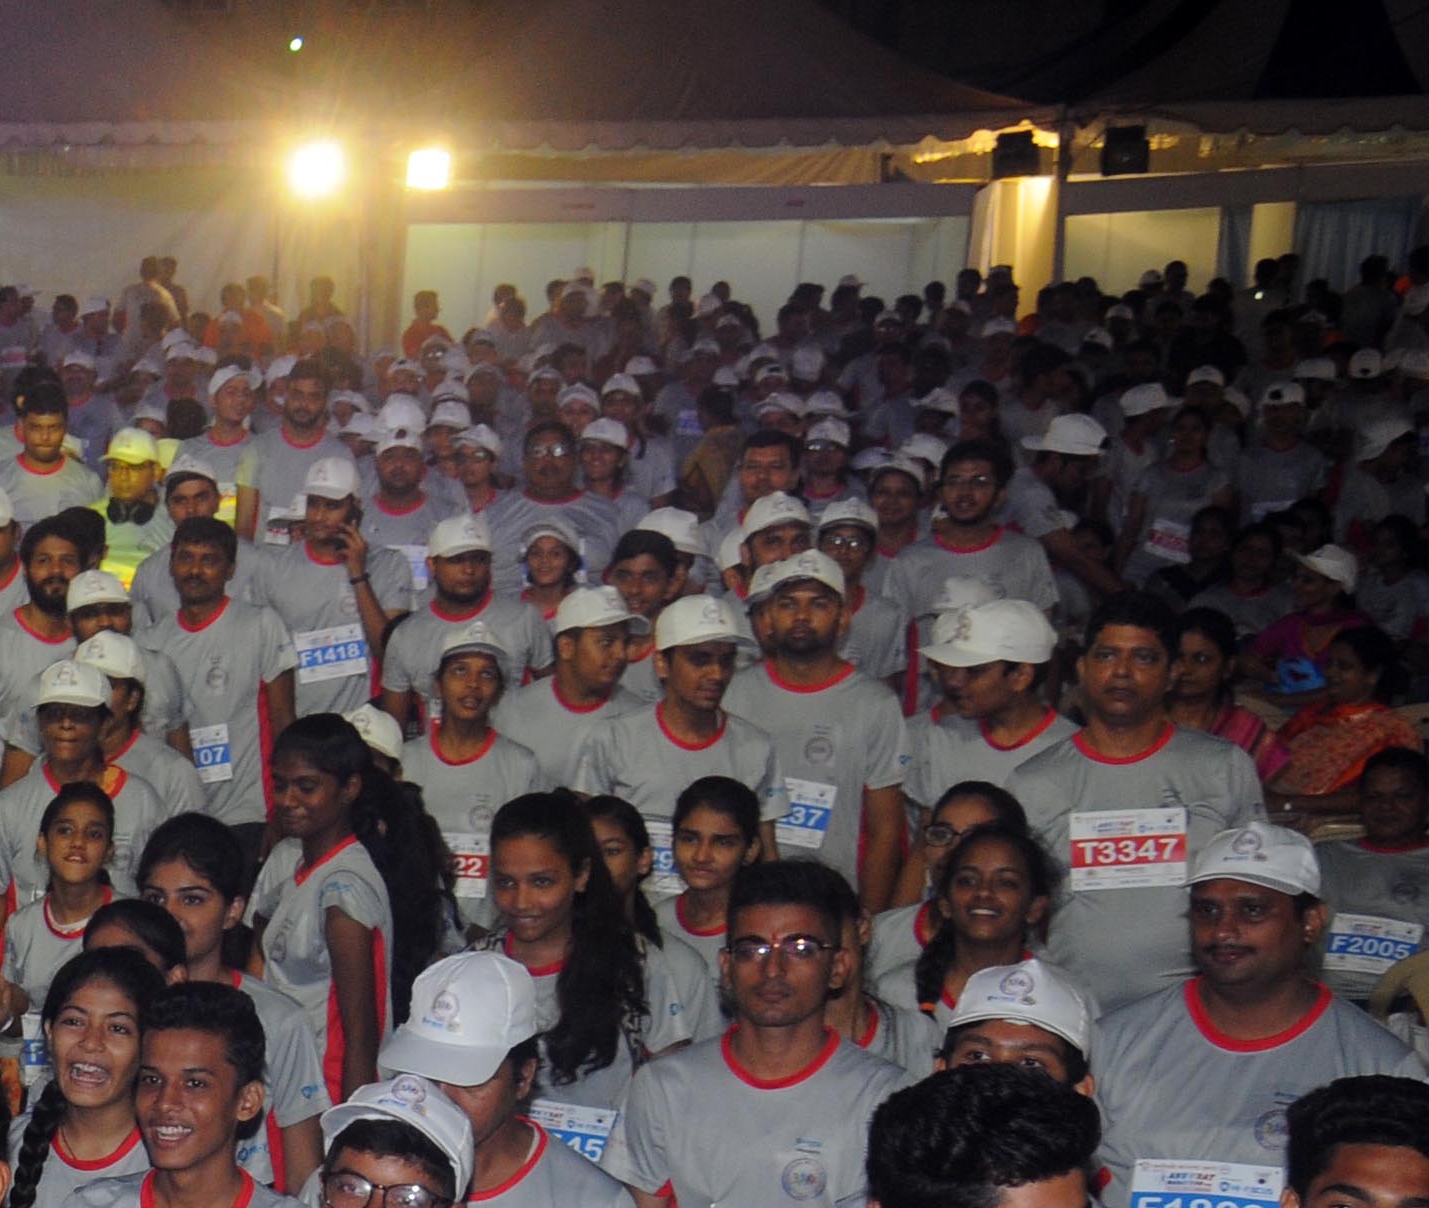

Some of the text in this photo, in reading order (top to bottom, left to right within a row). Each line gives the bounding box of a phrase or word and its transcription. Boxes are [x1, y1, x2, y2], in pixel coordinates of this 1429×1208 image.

[301, 642, 361, 668] F1418
[1077, 836, 1178, 864] T3347
[1331, 934, 1413, 960] F2005
